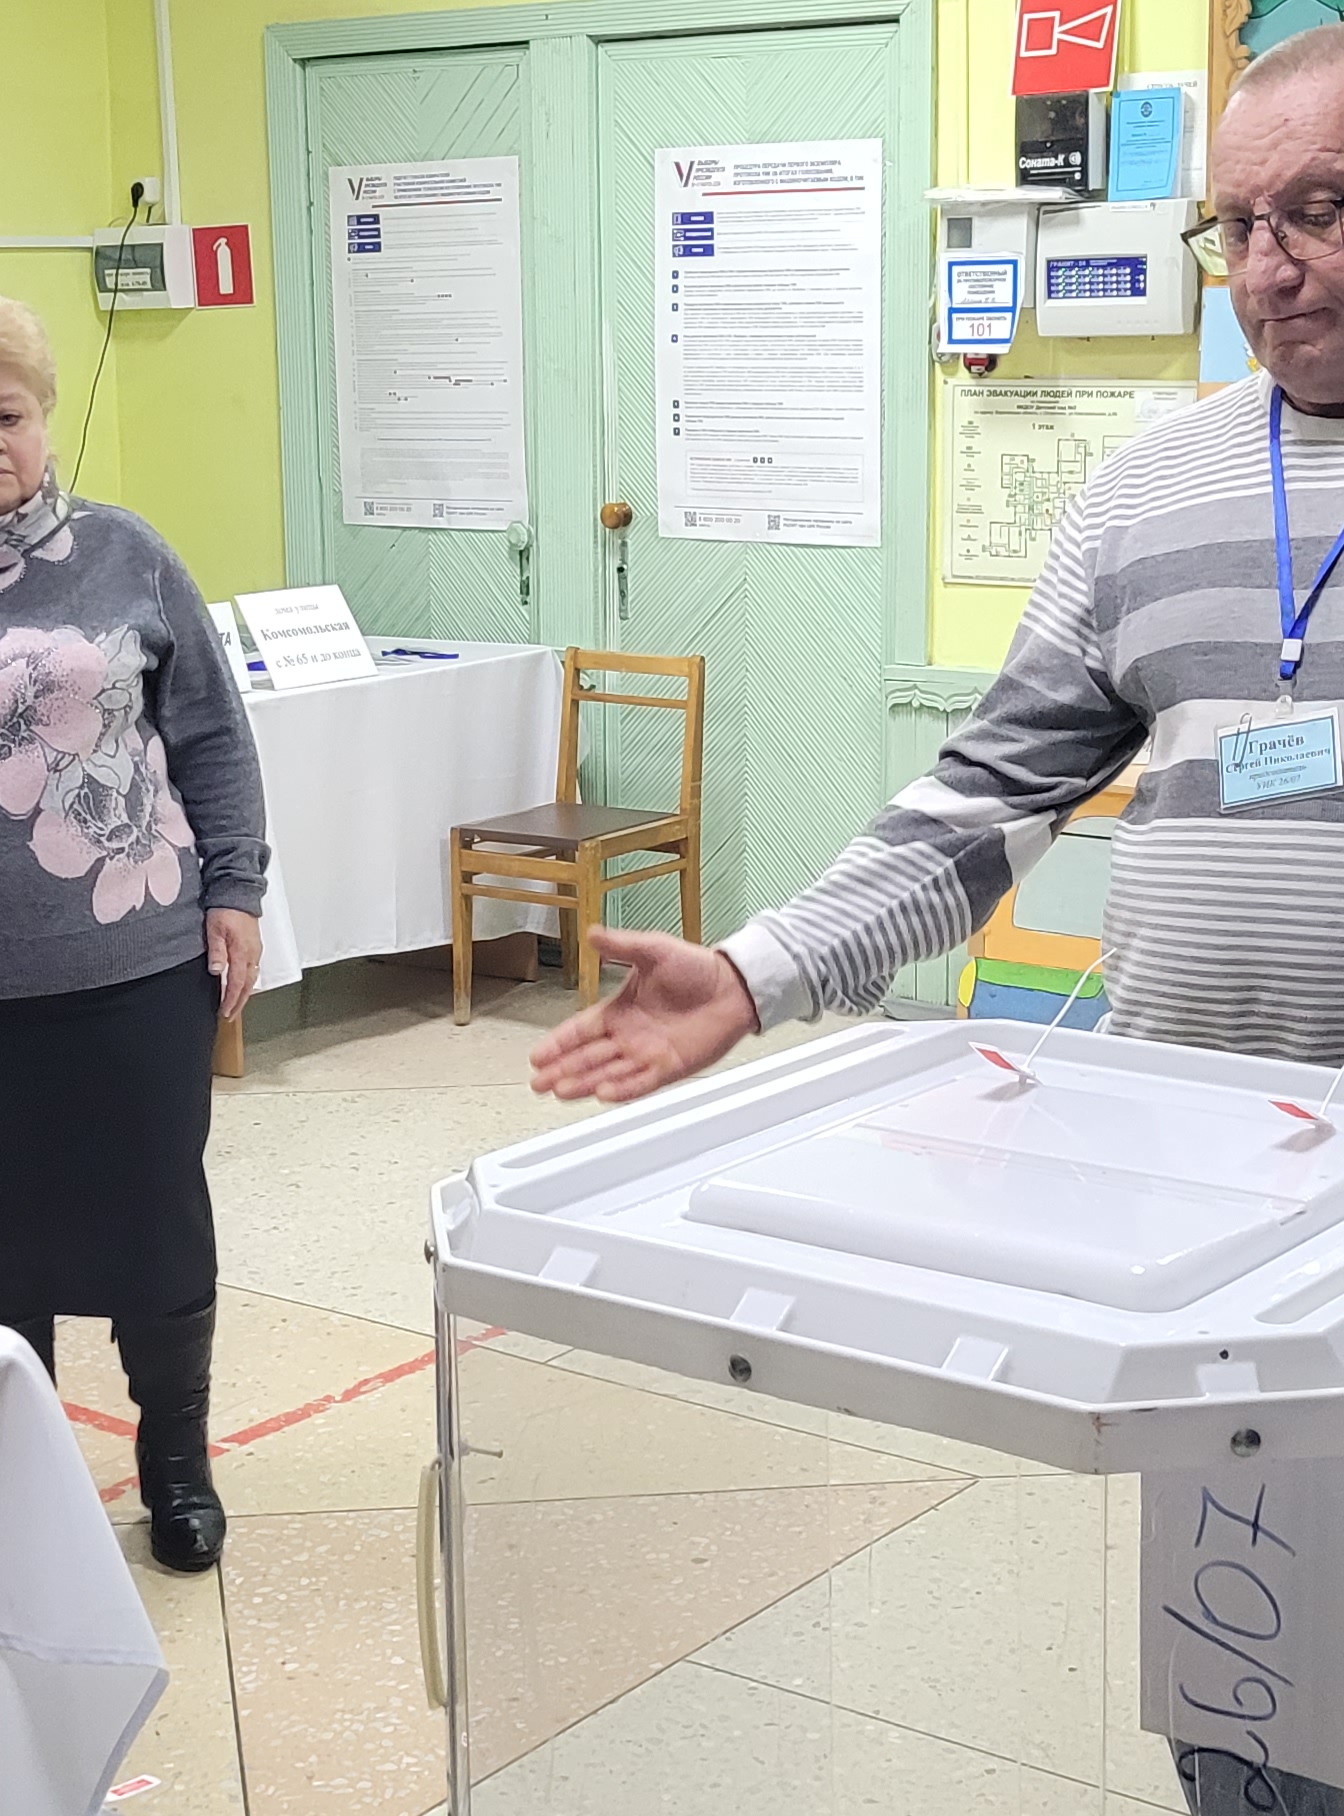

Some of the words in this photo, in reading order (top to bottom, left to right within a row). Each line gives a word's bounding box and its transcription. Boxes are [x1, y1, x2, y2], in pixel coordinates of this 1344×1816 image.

[969, 322, 992, 337] 101
[960, 389, 984, 398] ПЛАН
[986, 389, 1038, 399] ЭВАКУАЦИИ
[1040, 388, 1073, 399] ЛЮДЕЙ
[1074, 390, 1093, 399] ПРИ
[1095, 390, 1135, 399] ПОЖАРЕ
[260, 620, 351, 642] Комсомольская
[296, 652, 309, 666] 65
[311, 653, 319, 664] и
[320, 651, 332, 663] до
[333, 647, 362, 661] конца
[1248, 734, 1305, 755] Грачёв
[1225, 759, 1261, 774] Сергей
[1264, 748, 1331, 766] Николаевич
